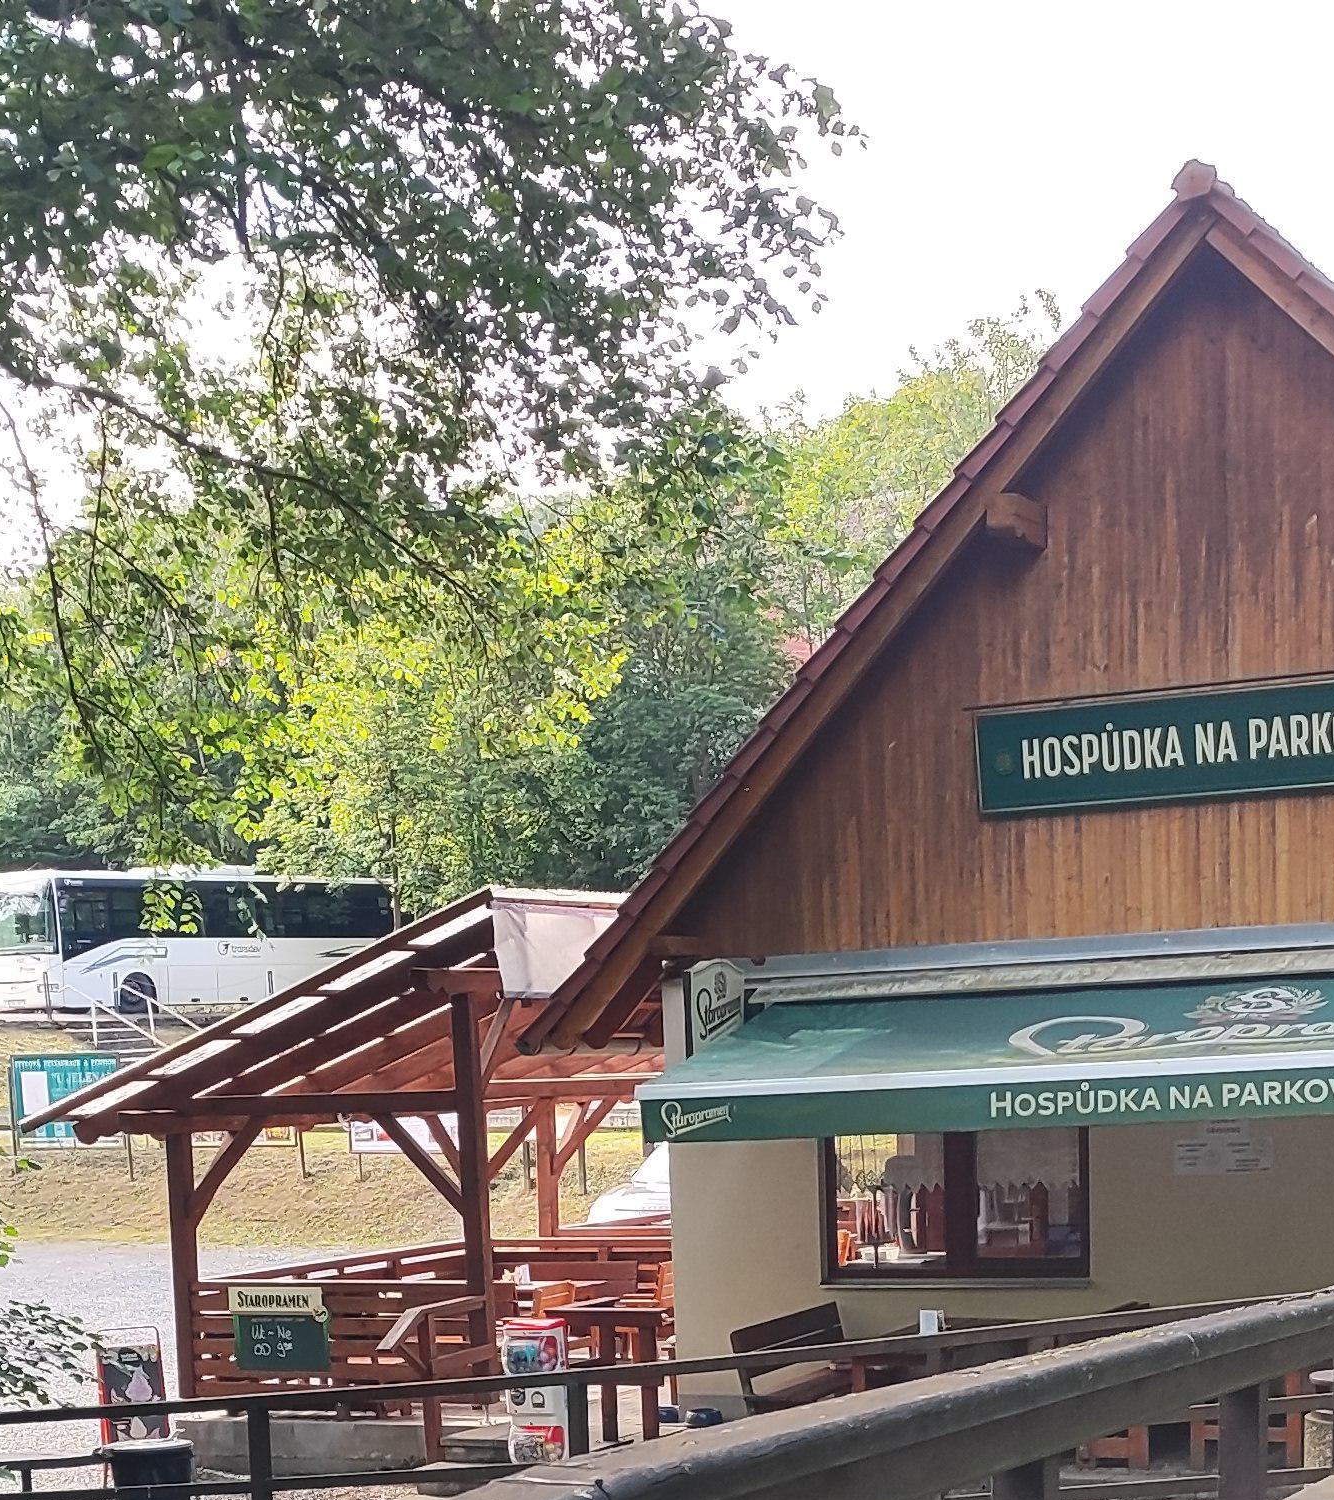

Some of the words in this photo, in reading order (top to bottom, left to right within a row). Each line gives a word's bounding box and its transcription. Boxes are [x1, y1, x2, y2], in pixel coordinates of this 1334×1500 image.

[1021, 722, 1184, 780] HOSPŮDKA
[1195, 719, 1238, 765] NA
[697, 988, 742, 1040] Starop
[990, 1082, 1162, 1117] HOSPŮDKA
[1169, 1085, 1213, 1110] NA
[661, 1101, 732, 1138] Staropramen
[237, 1290, 309, 1308] STAROPRAMEN
